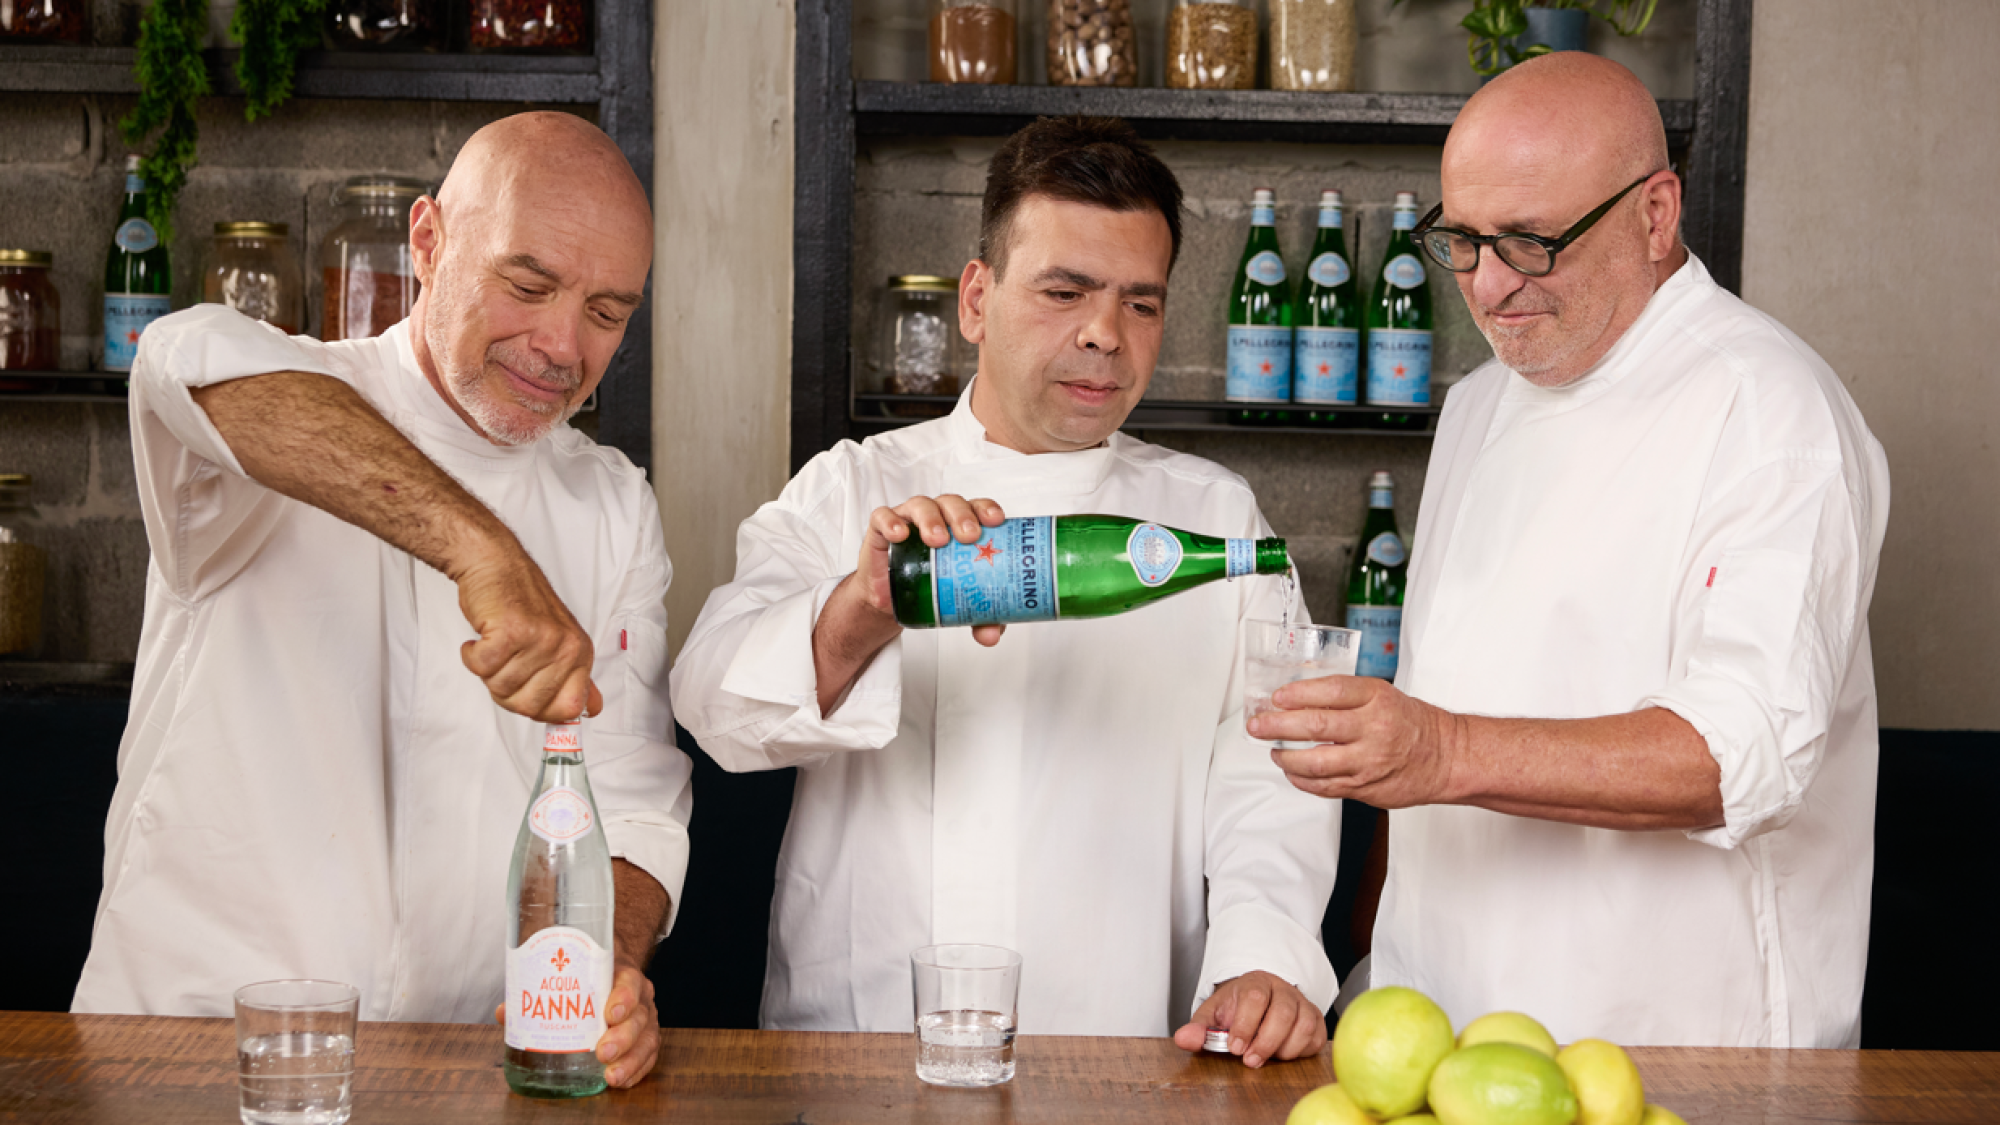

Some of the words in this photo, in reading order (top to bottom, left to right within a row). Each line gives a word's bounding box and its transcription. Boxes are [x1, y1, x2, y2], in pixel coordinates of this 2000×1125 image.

[546, 732, 578, 746] PANNA
[540, 975, 581, 991] ACQUA
[521, 989, 596, 1021] PANNA
[539, 1022, 578, 1031] TUSCANY
